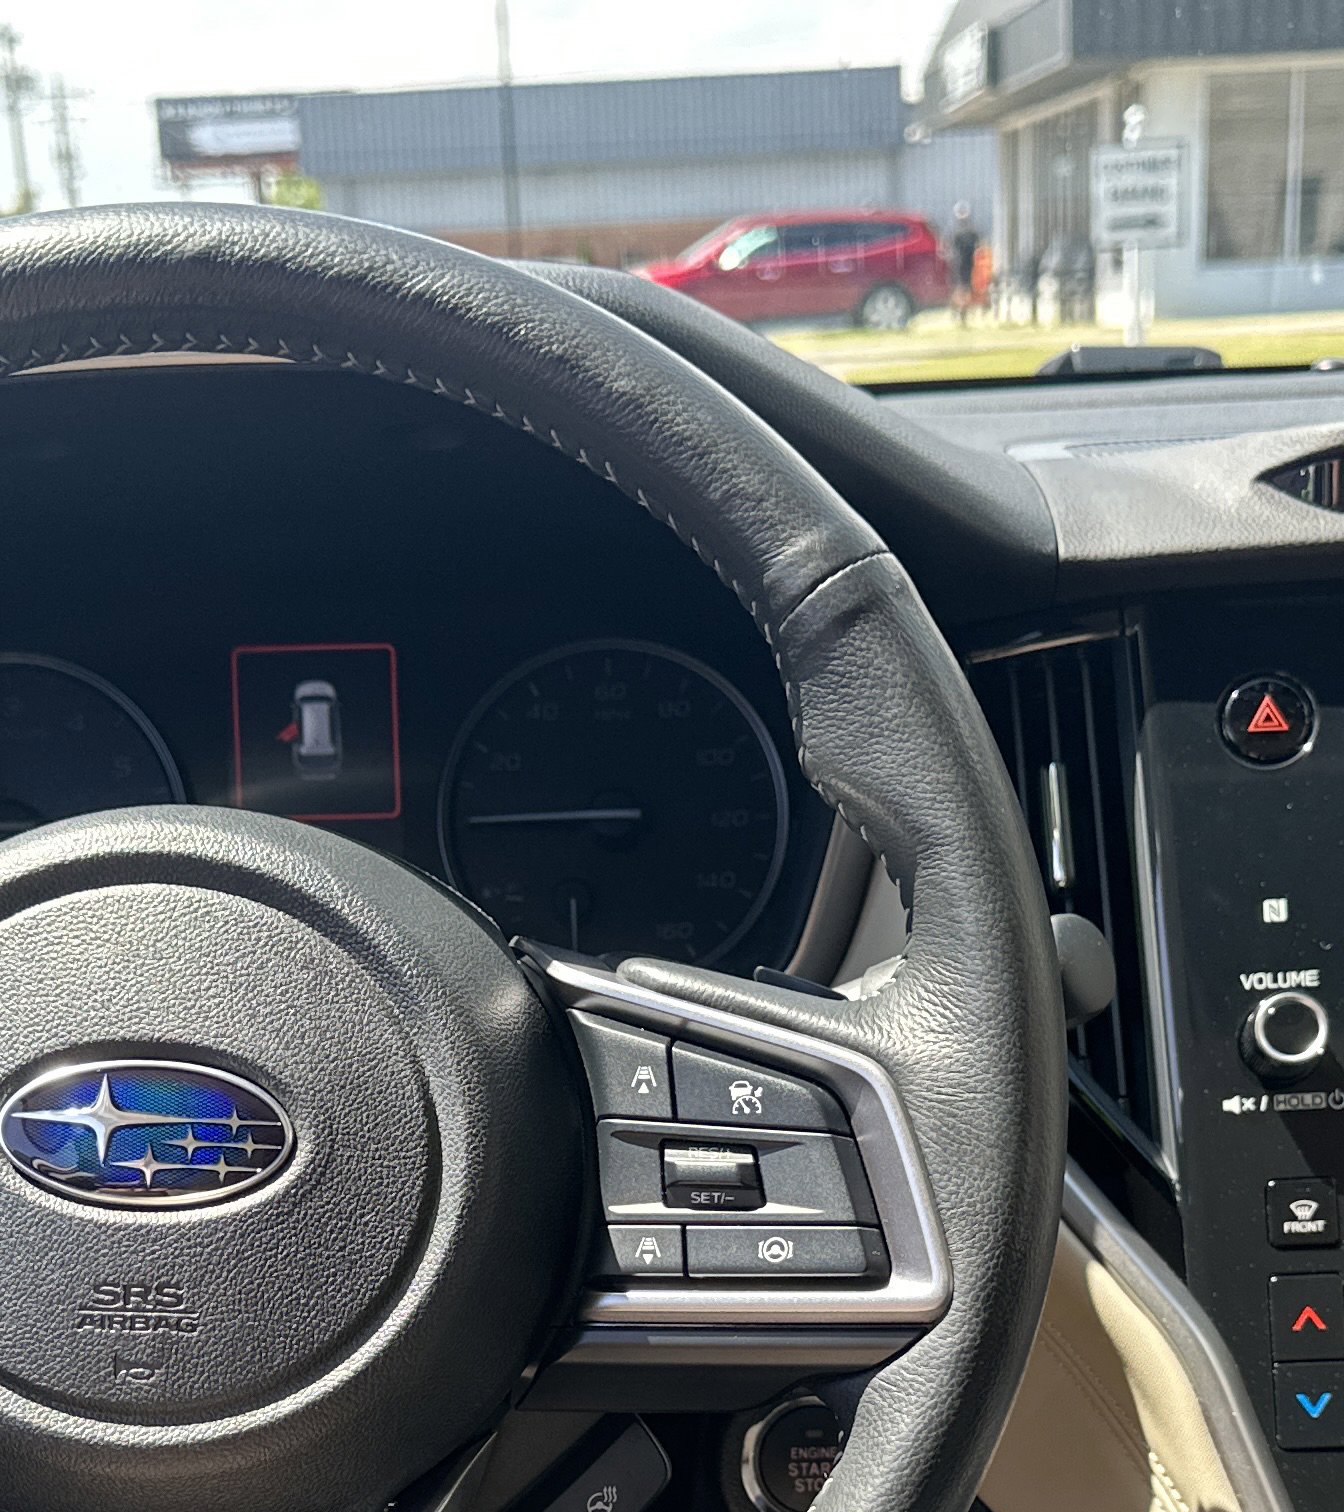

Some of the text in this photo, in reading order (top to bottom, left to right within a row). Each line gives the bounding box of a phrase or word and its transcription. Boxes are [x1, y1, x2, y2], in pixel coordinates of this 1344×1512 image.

[1239, 968, 1321, 991] VOLUME
[1275, 1093, 1325, 1110] HOLD
[1283, 1220, 1326, 1234] FRONT
[91, 1283, 186, 1311] SRS
[75, 1314, 201, 1334] AIRBAG
[789, 1446, 838, 1460] ENGINE
[787, 1462, 832, 1478] STAR
[794, 1478, 824, 1493] STO
